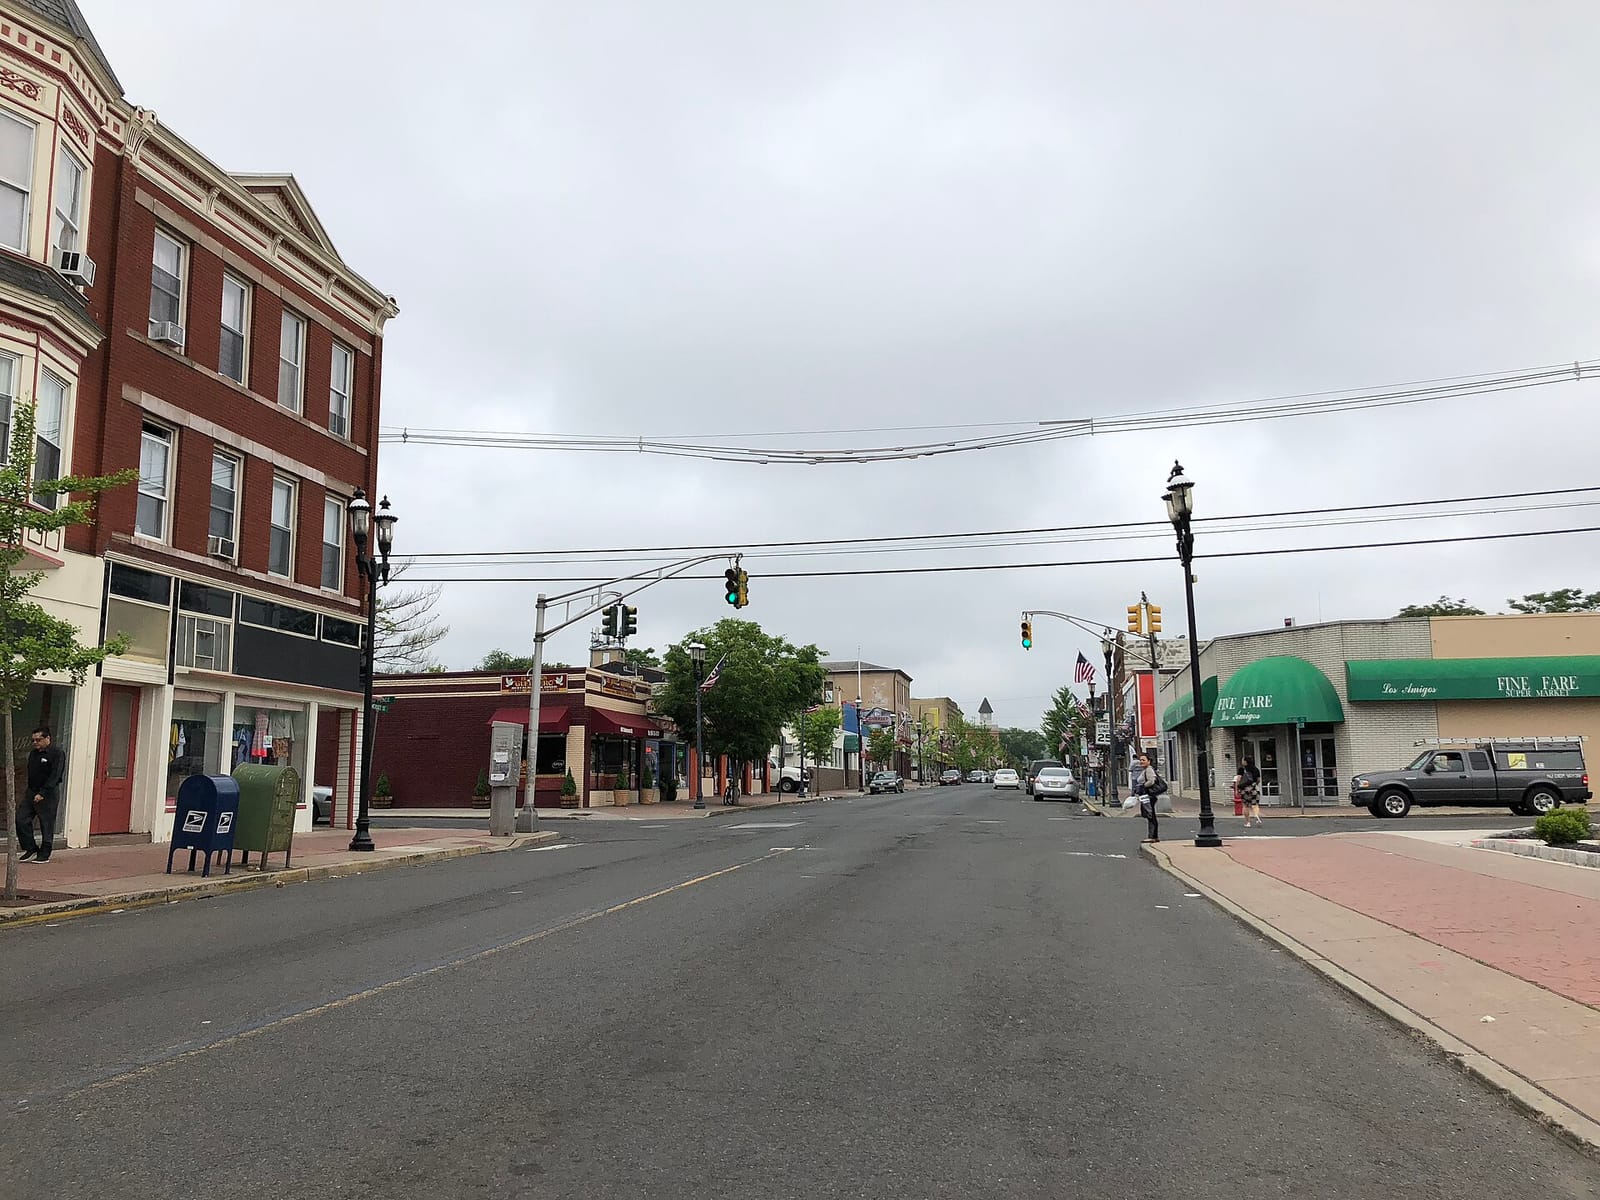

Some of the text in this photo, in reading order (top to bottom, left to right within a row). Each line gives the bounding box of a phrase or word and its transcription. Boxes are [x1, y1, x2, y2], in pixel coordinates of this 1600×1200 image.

[1497, 675, 1579, 690] FINE FARE
[1382, 683, 1437, 697] Los Amigos
[1536, 689, 1570, 697] MARKET
[1242, 695, 1273, 709] FARE
[1097, 733, 1111, 742] 25
